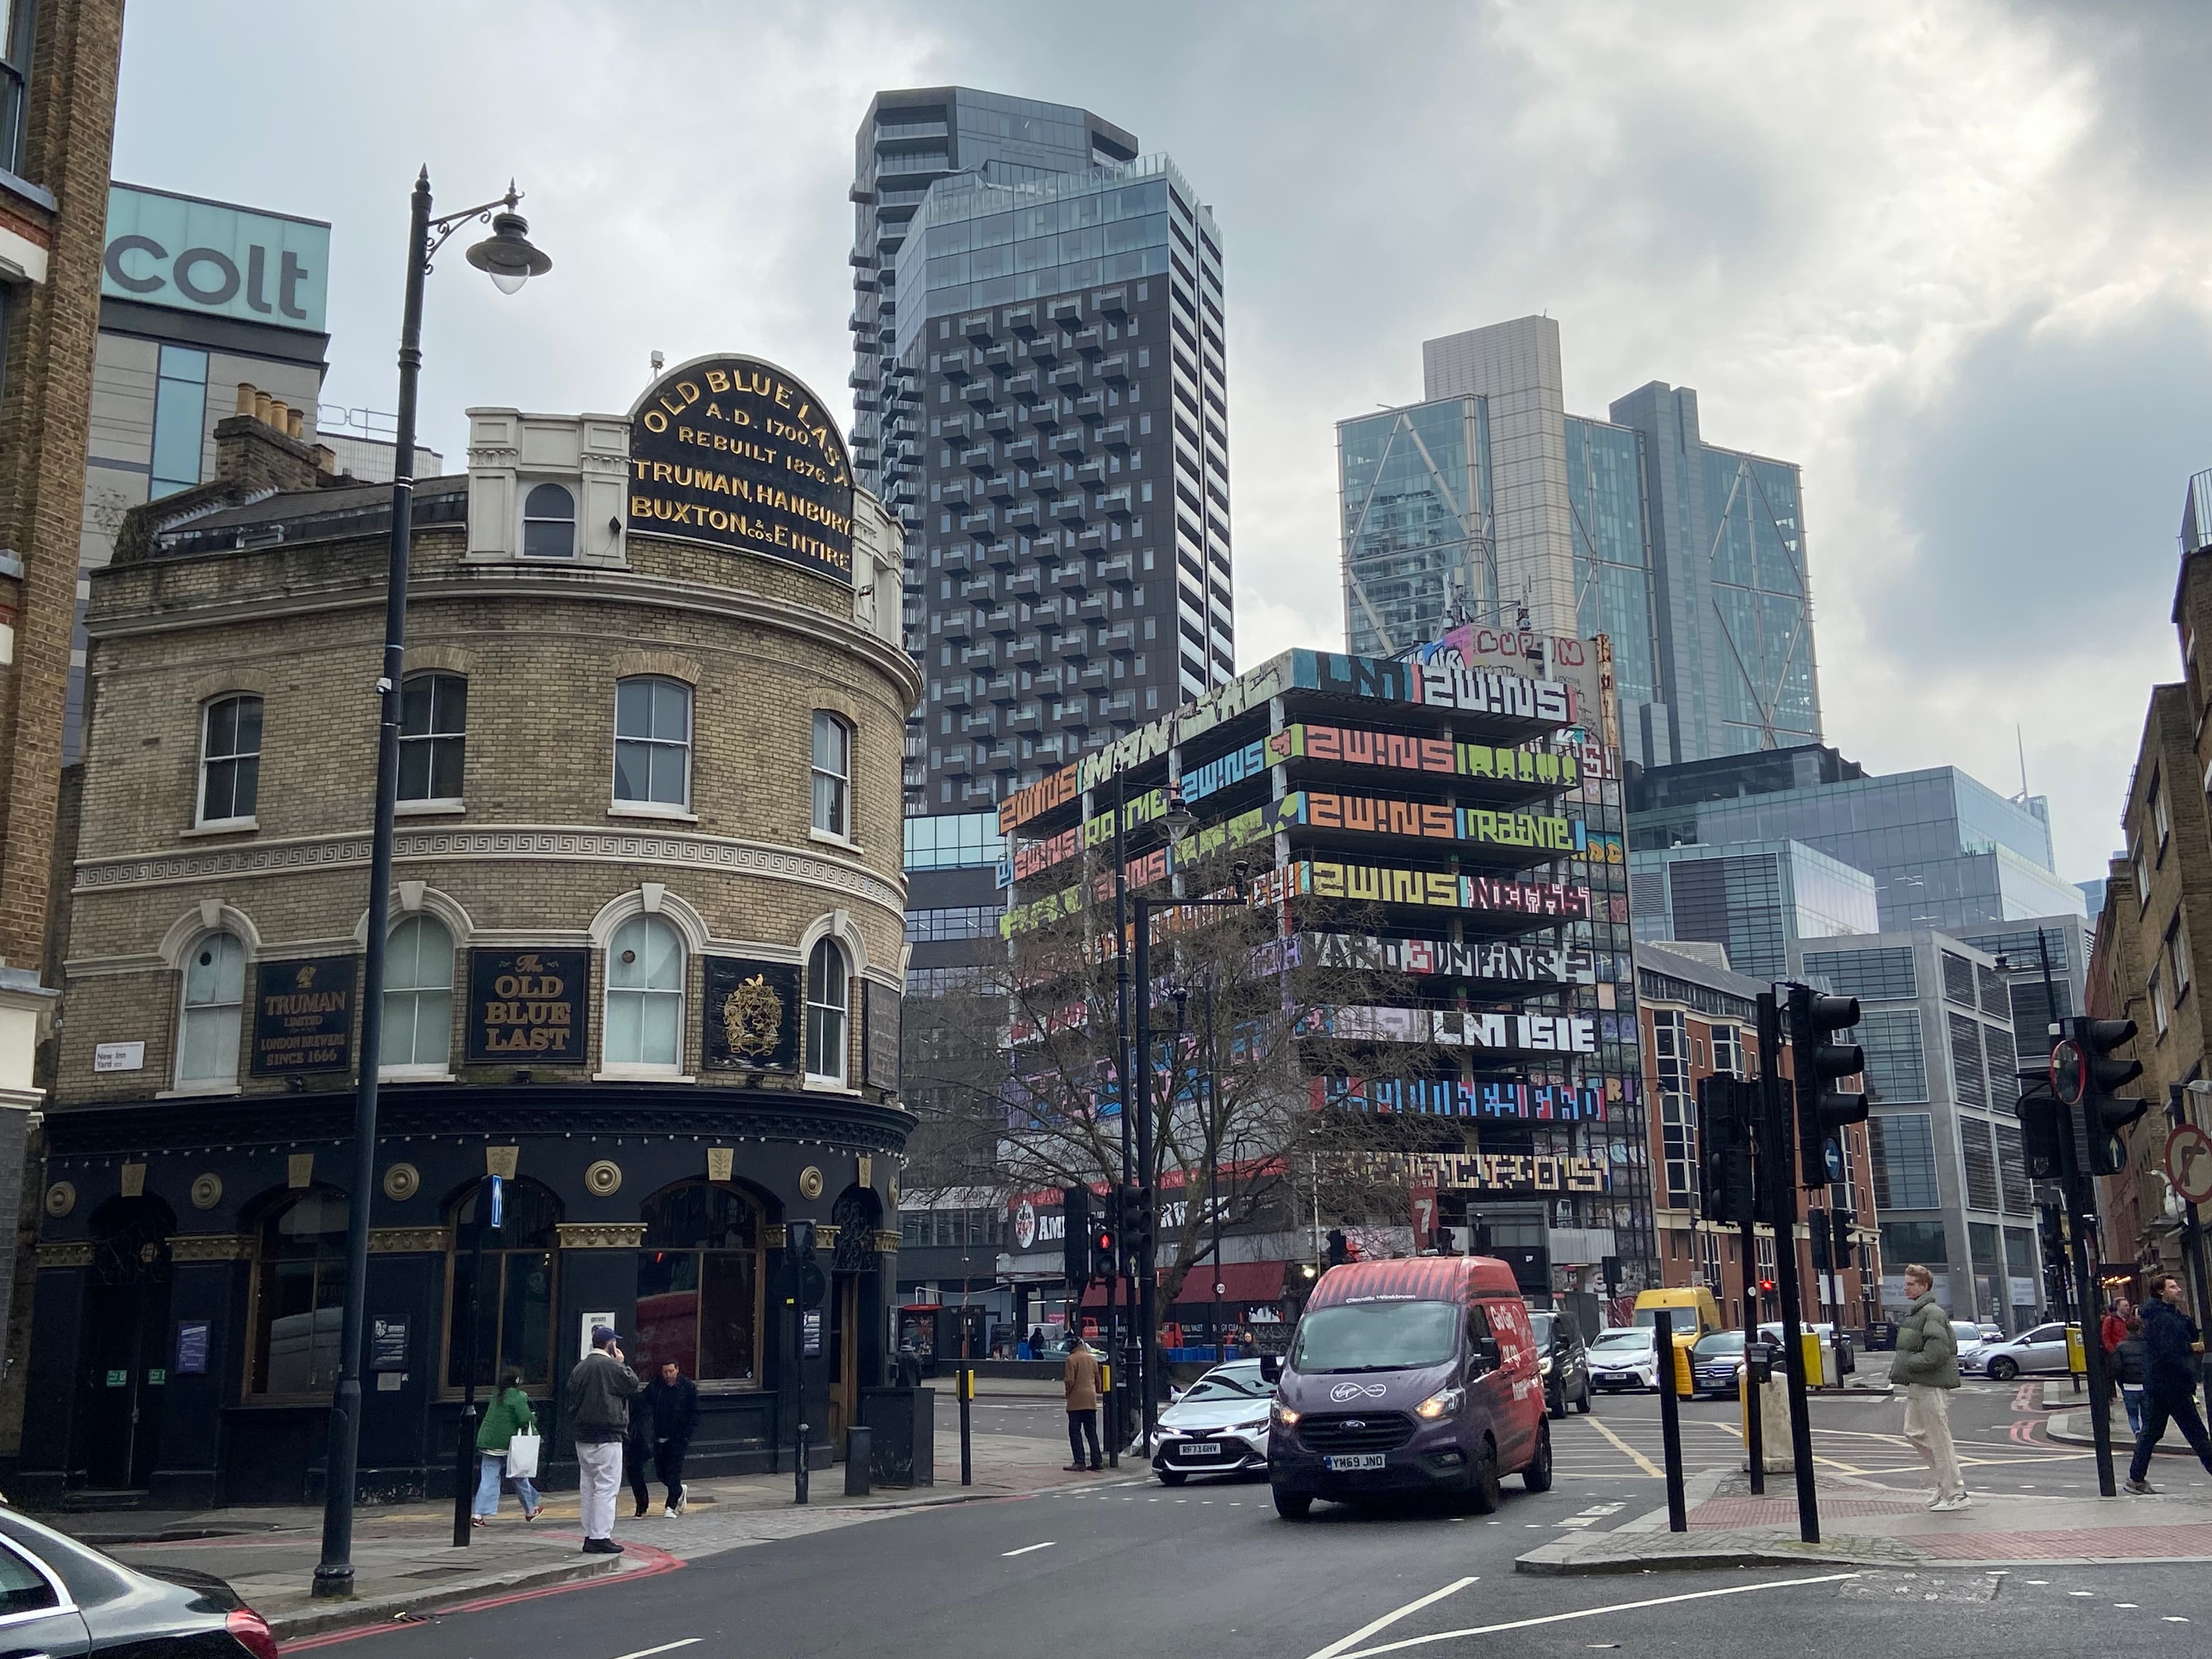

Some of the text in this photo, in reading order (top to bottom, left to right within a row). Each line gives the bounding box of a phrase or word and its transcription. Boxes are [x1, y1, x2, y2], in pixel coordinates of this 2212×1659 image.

[104, 234, 308, 320] colt
[643, 369, 850, 488] OLD BLUE LAST
[679, 426, 777, 464] REBUILT
[631, 495, 747, 536] BUXTON
[495, 975, 563, 998] OLD
[265, 991, 346, 1016] TRUMAN
[484, 1002, 571, 1024] BLUE
[260, 1037, 300, 1051] LONDON
[485, 1028, 570, 1051] LAST
[97, 1060, 111, 1069] Yard
[267, 1048, 337, 1066] SINCE 1666
